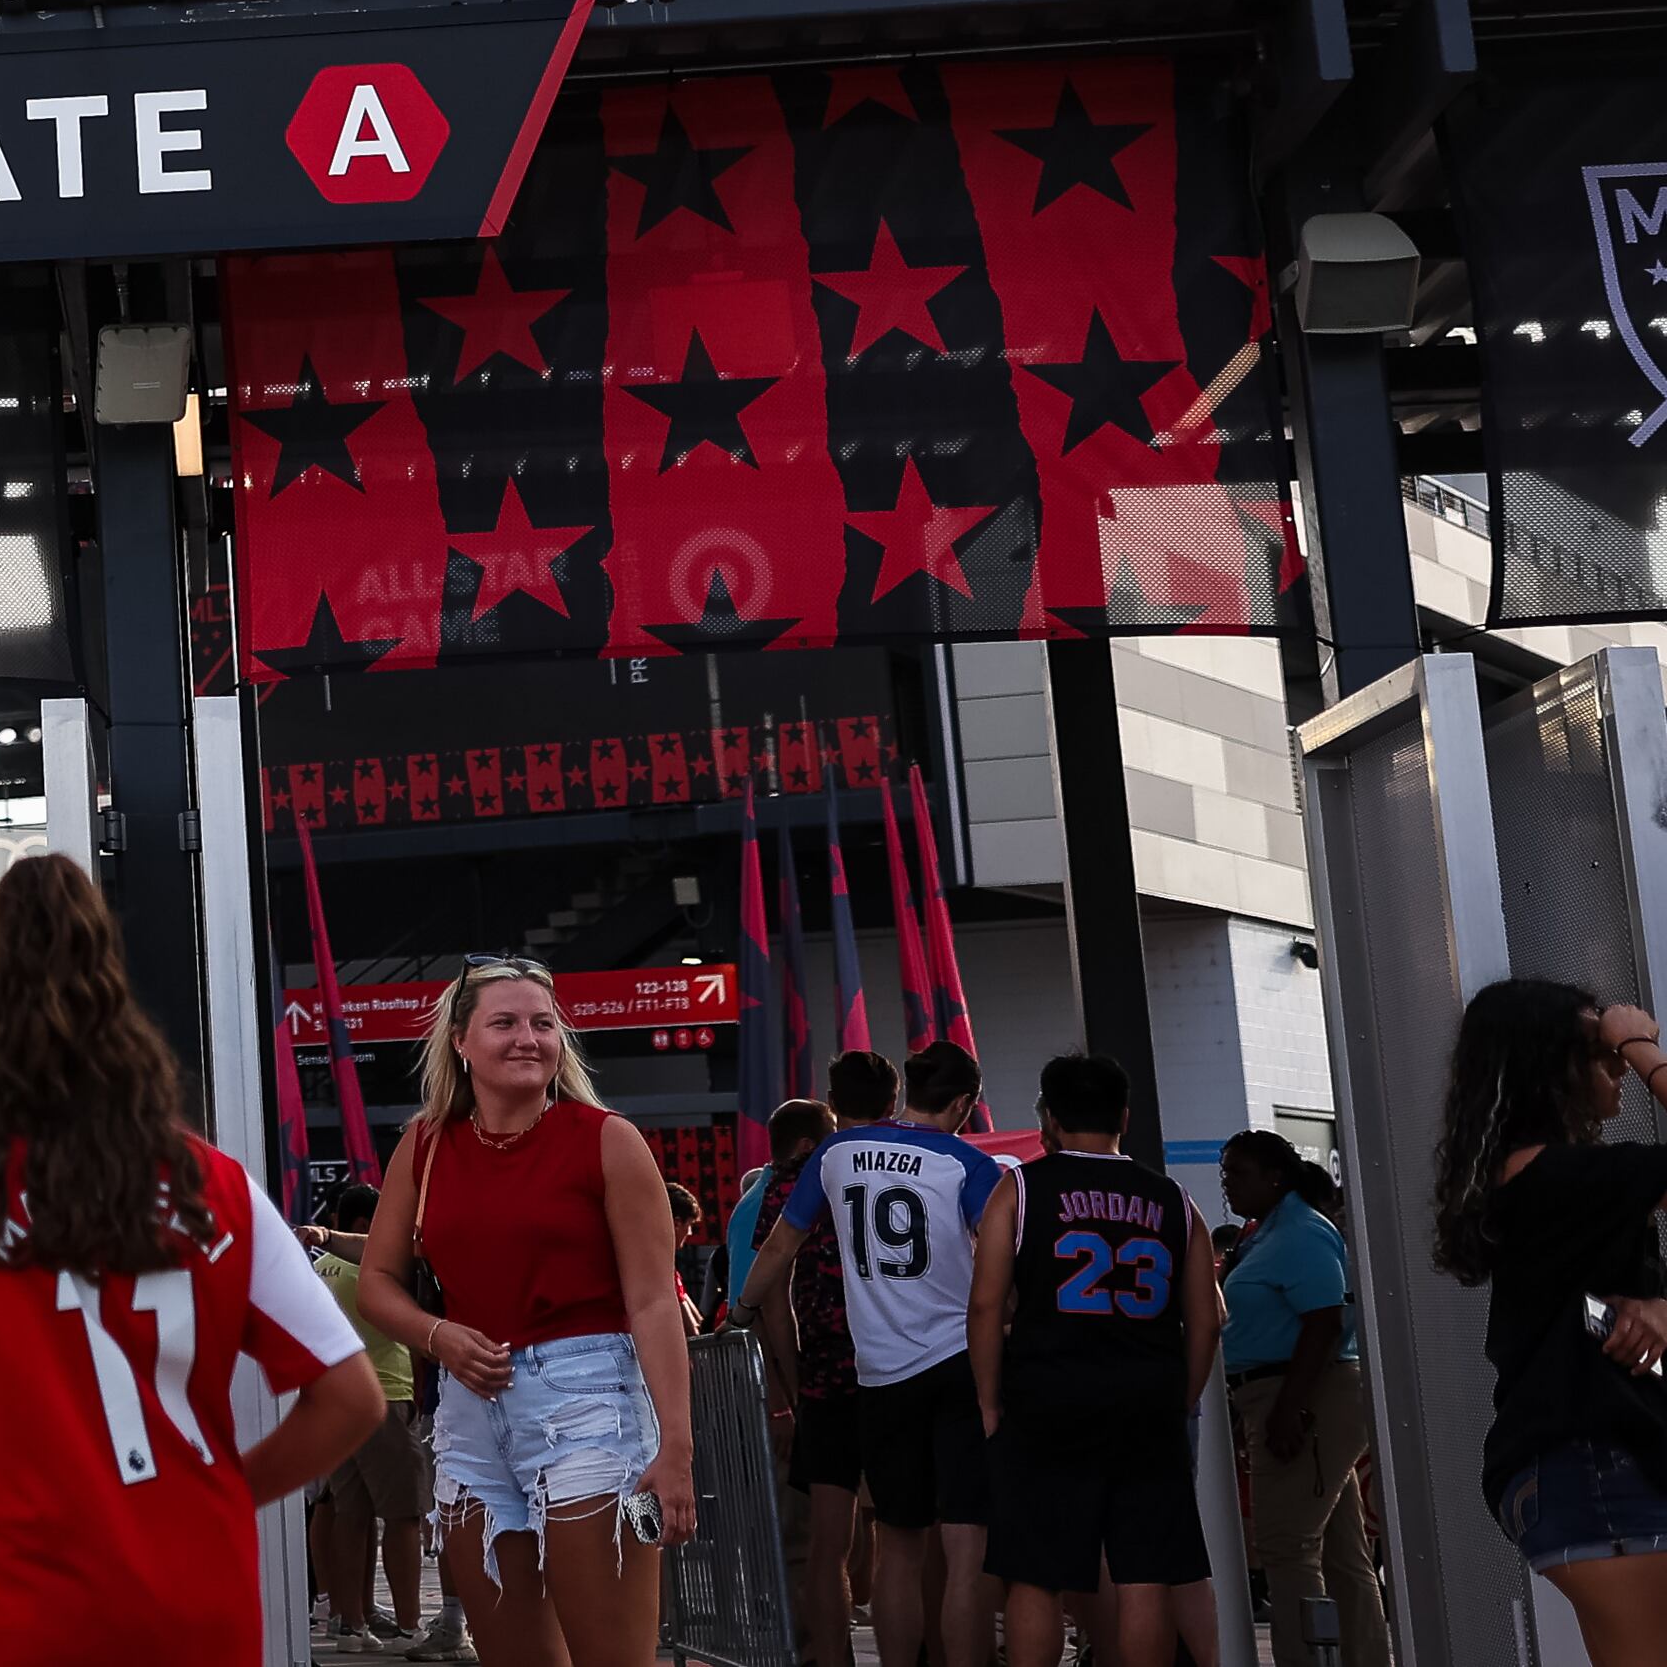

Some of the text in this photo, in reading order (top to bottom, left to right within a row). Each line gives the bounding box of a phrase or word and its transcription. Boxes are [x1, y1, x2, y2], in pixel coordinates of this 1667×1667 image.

[327, 83, 411, 177] A
[852, 1151, 923, 1176] MIAZGA
[843, 1182, 931, 1281] 19
[1058, 1190, 1164, 1232] JORDAN
[1054, 1231, 1173, 1319] 23
